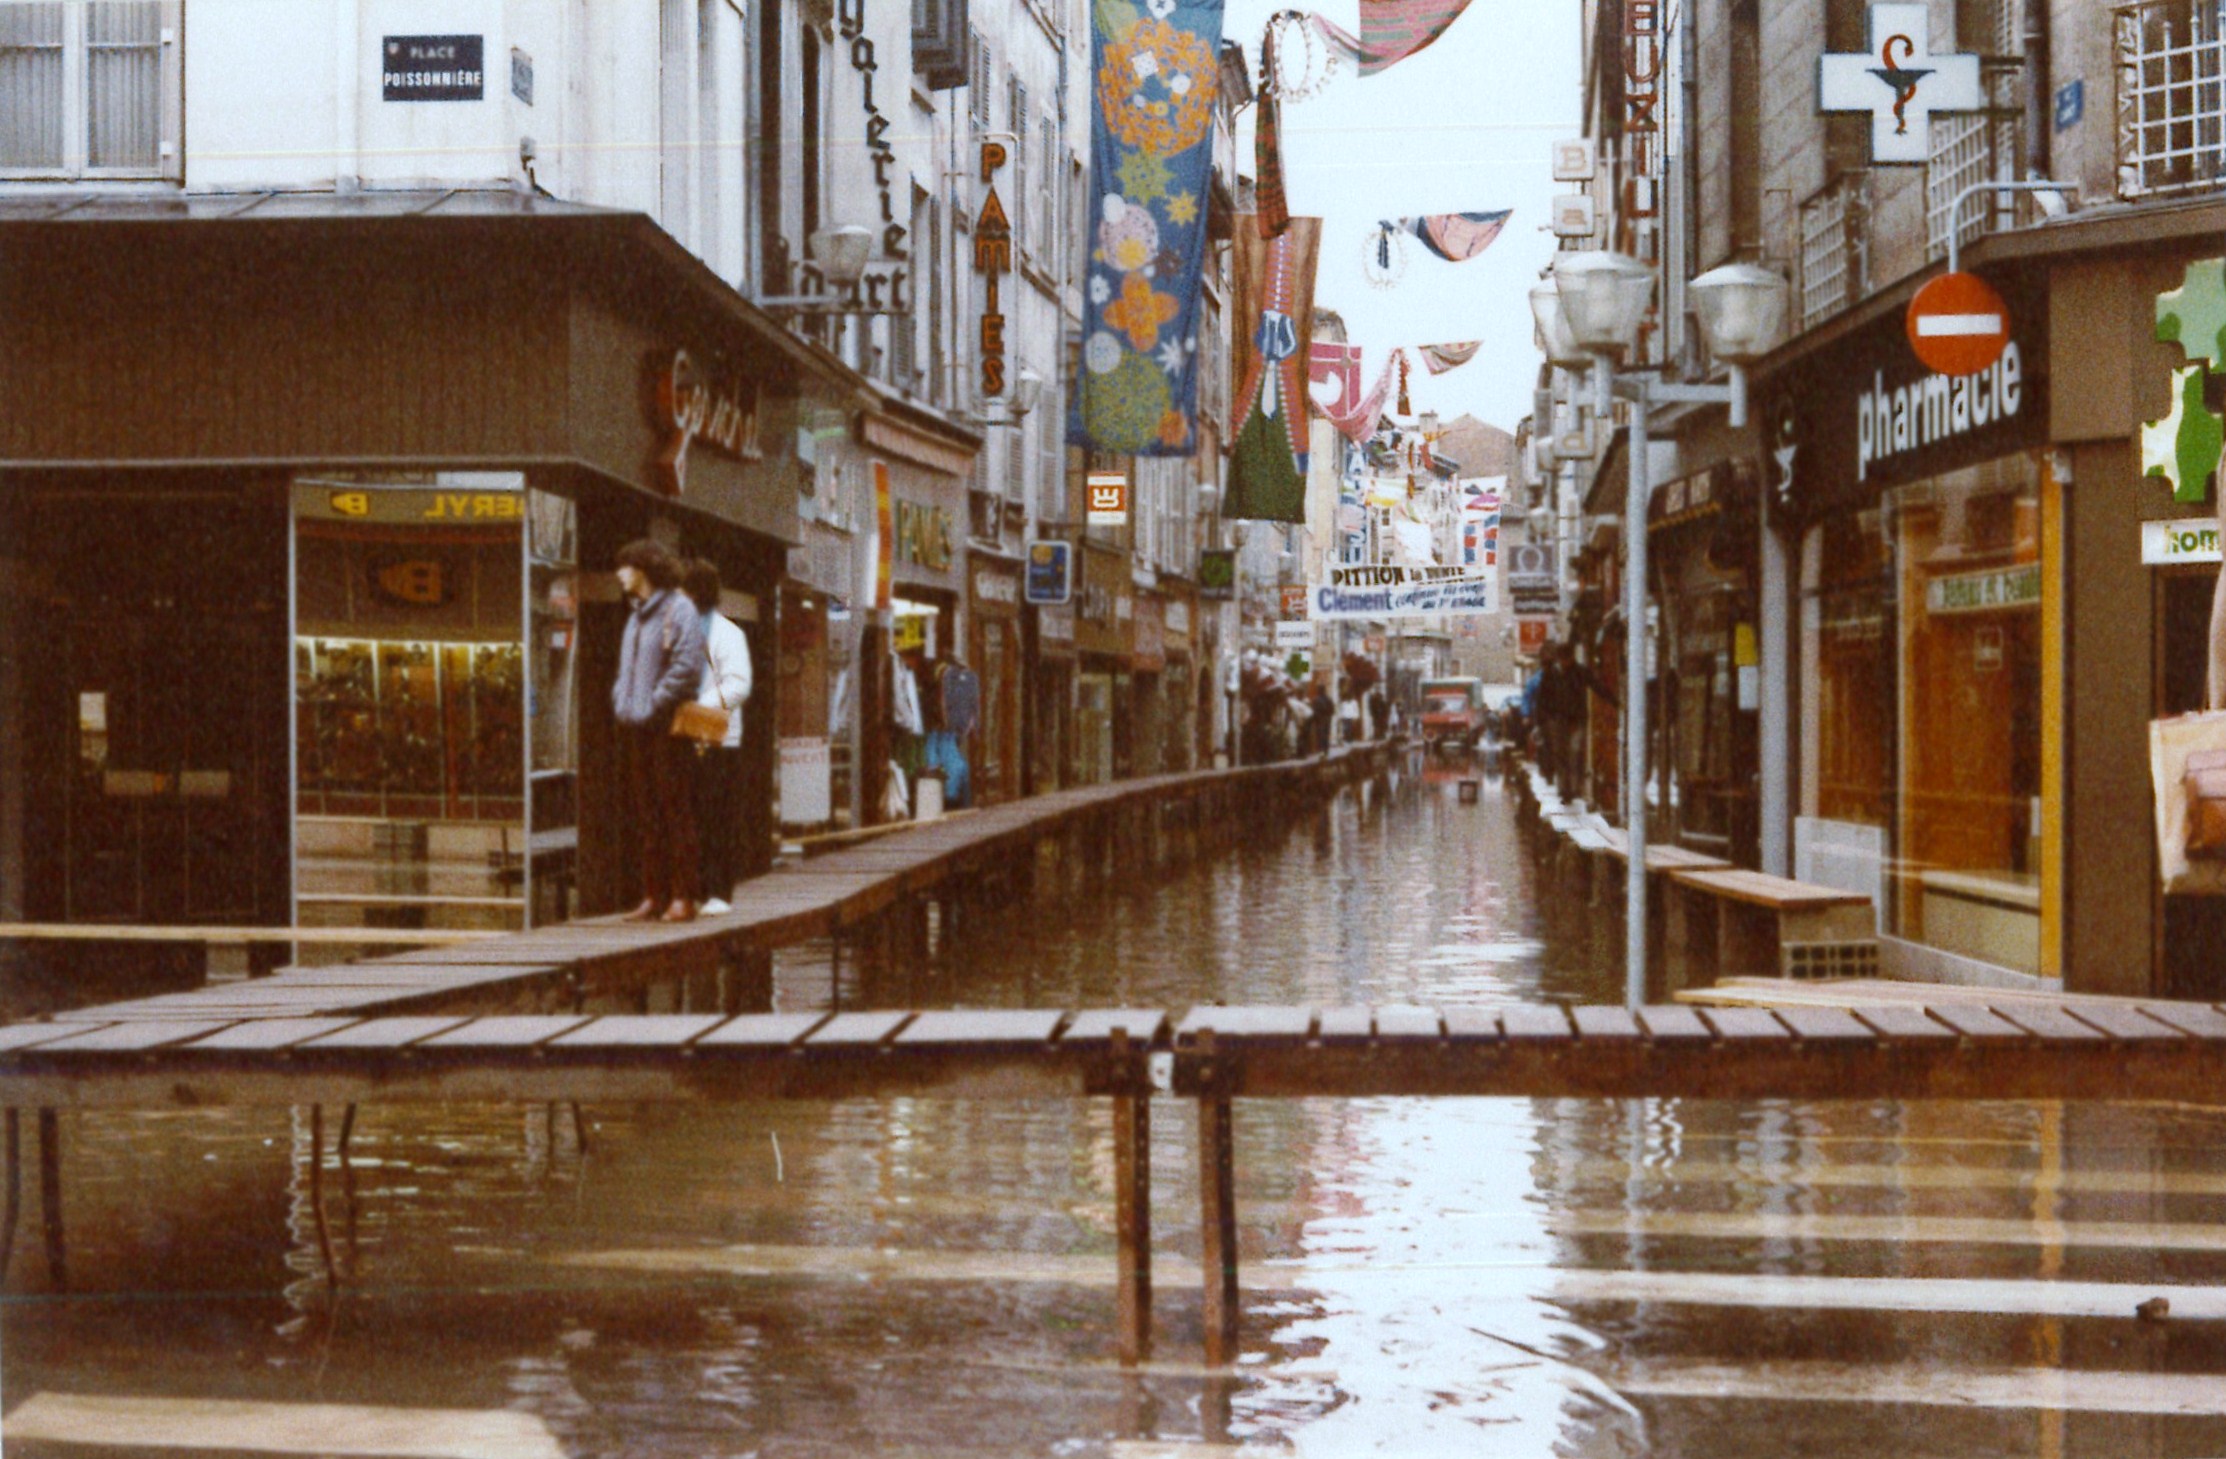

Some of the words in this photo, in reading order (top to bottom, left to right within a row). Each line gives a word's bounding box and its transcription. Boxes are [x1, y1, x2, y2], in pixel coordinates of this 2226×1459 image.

[410, 46, 455, 59] PLACE
[384, 69, 482, 87] POISSONNIÈRE
[1857, 341, 2022, 482] pharmacie
[1331, 566, 1406, 587] PITTION
